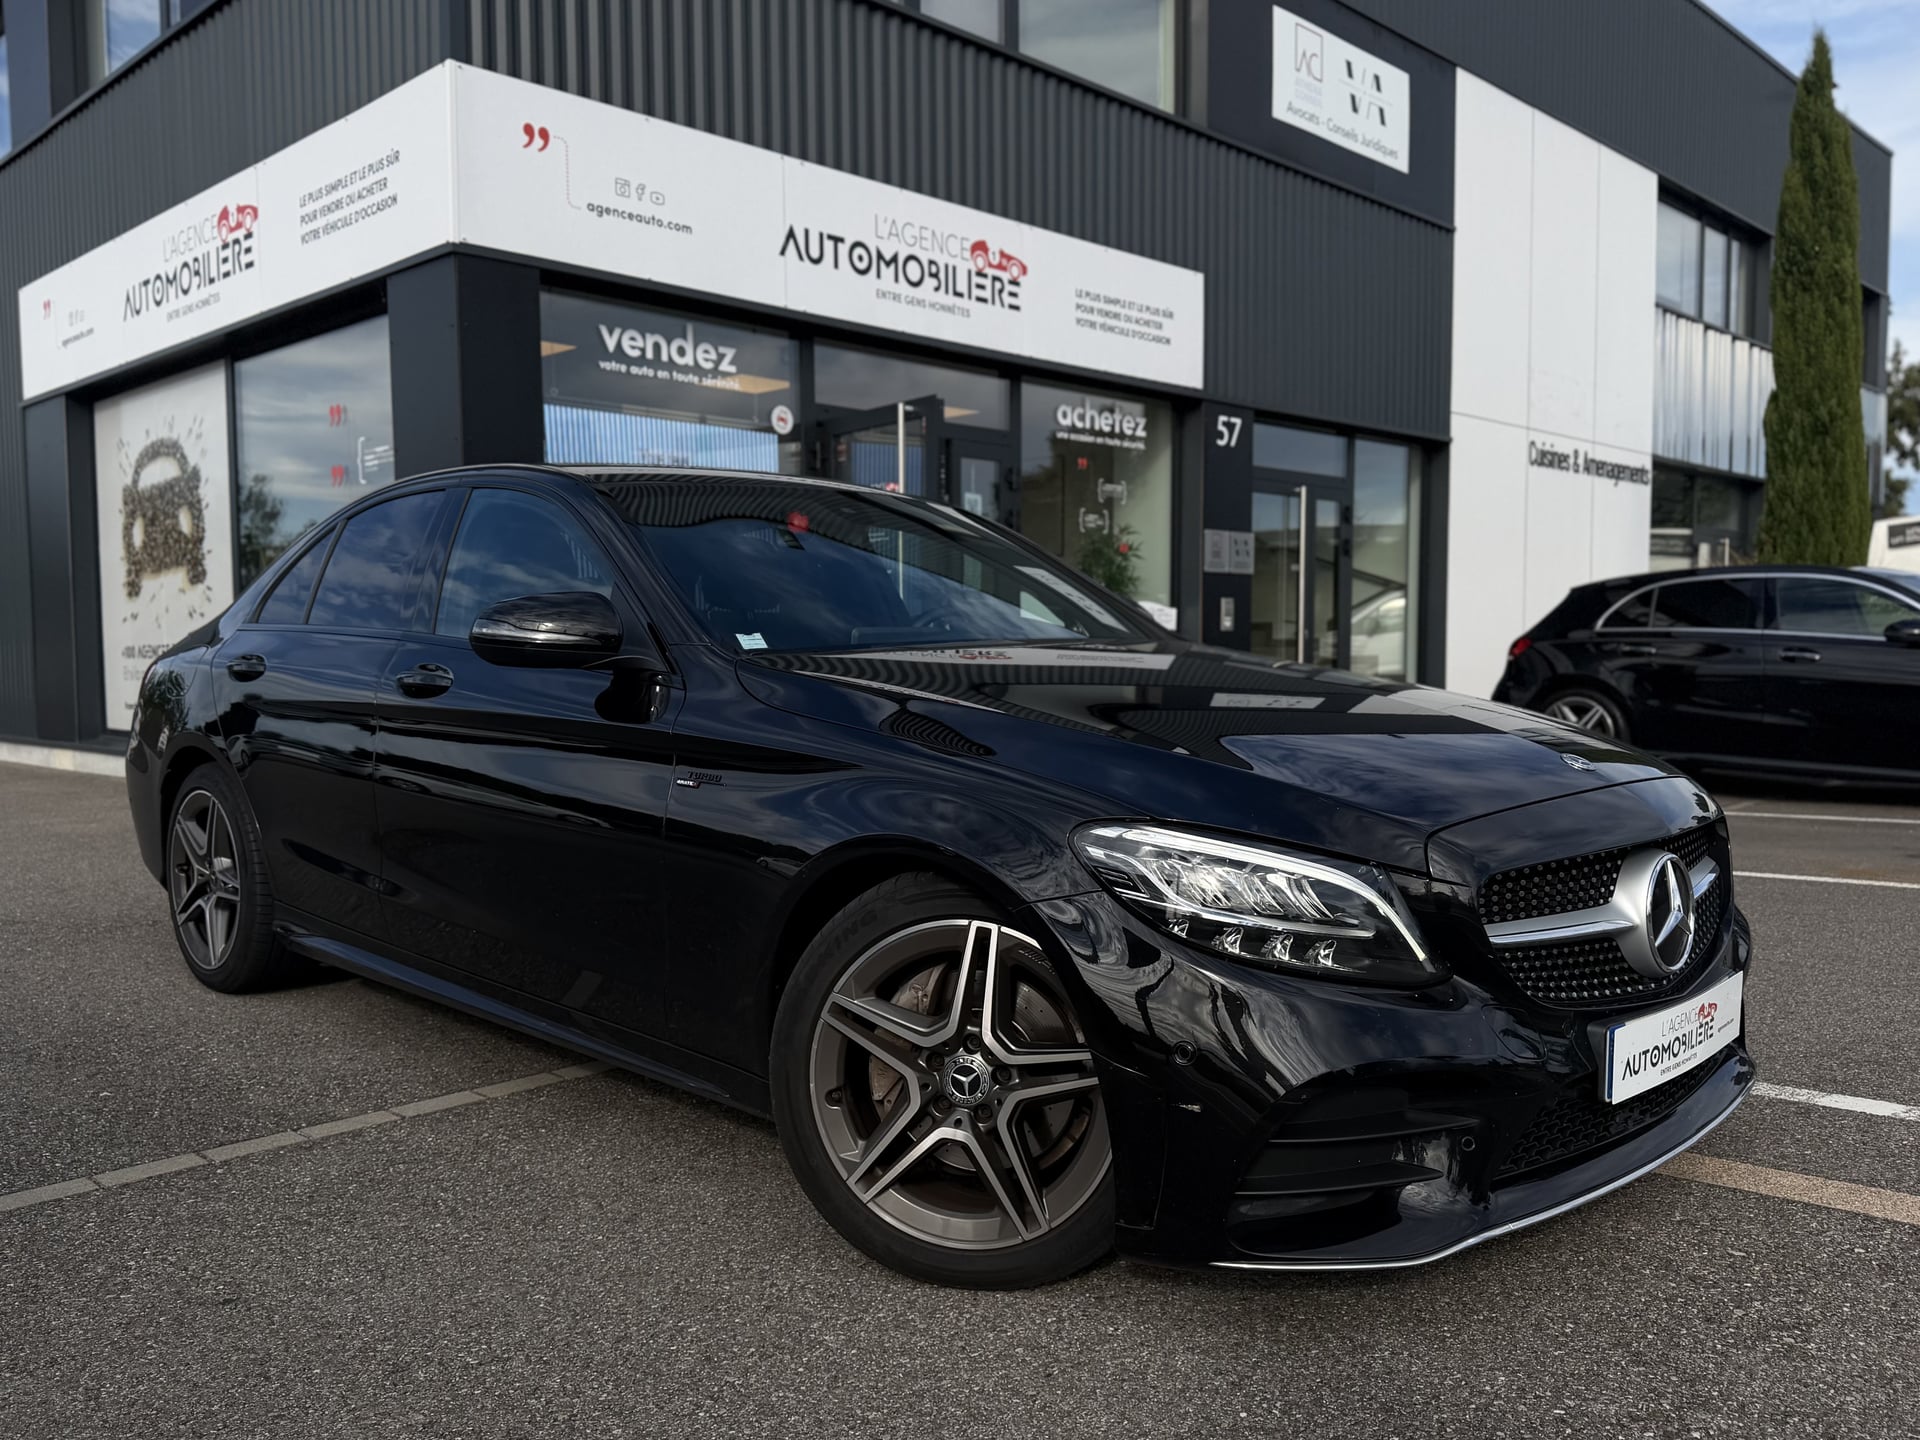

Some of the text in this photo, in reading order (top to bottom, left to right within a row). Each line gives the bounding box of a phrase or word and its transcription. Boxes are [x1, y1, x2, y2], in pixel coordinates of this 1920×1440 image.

[1326, 117, 1359, 143] Conseils
[299, 194, 306, 208] LE
[307, 187, 324, 205] PLUS
[324, 175, 348, 197] SIMPLE
[350, 170, 358, 185] ET
[359, 166, 366, 181] LE
[367, 157, 384, 176] PLUS
[300, 177, 388, 227] POUR VENDRE OU ACHETER
[586, 201, 693, 234] agenceauto.com
[163, 213, 217, 263] L'AGENCE
[300, 226, 321, 246] VOTRE
[874, 212, 970, 262] L'AGENCE
[876, 288, 902, 304] ENTRE
[904, 295, 926, 309] GENS
[1075, 288, 1083, 299] LE
[1085, 290, 1101, 303] PLUS
[1145, 304, 1160, 317] PLUS
[1076, 302, 1094, 315] POUR
[598, 323, 738, 373] vendez
[598, 360, 627, 373] votre
[629, 364, 655, 378] auto
[656, 369, 670, 380] en
[672, 370, 699, 384] toute
[1056, 397, 1147, 437] achetez
[1216, 415, 1242, 448] 57
[1528, 440, 1570, 472] Cuisines
[1572, 448, 1580, 474] &
[1661, 1007, 1699, 1037] L'AGENCE
